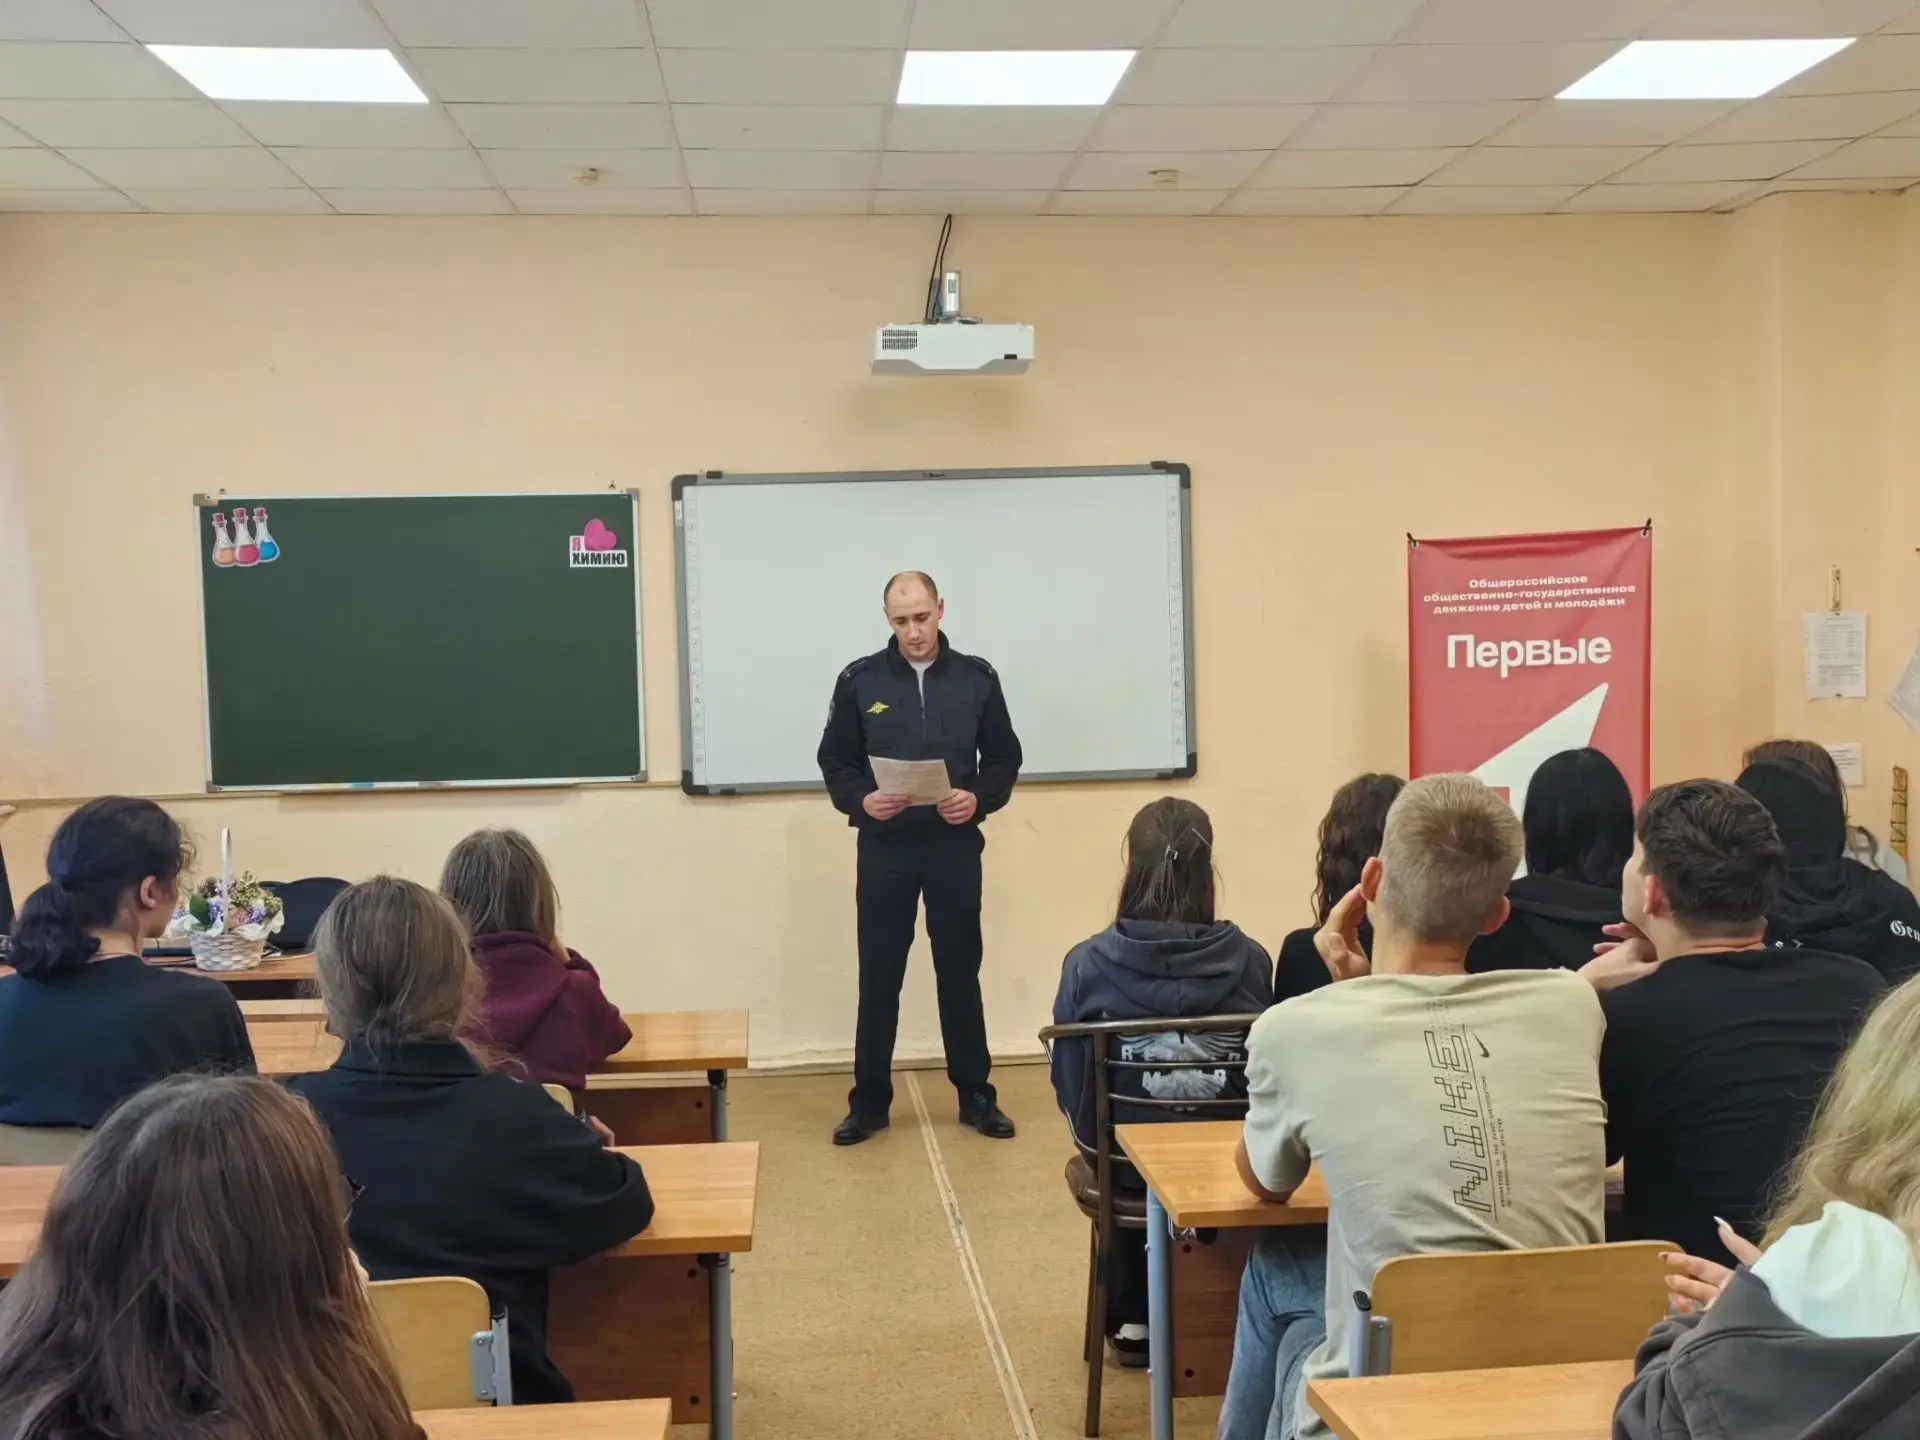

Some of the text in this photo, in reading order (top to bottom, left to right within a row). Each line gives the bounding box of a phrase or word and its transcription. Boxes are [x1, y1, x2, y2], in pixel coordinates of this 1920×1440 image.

[572, 537, 581, 551] Я
[572, 552, 625, 565] ХИМИЮ
[1469, 576, 1588, 589] Общероссийское
[1423, 584, 1636, 602] общественно-государственное
[1433, 598, 1625, 615] движение детей и молодёжи
[1447, 635, 1612, 678] Первые
[1424, 1031, 1492, 1213] NIKE
